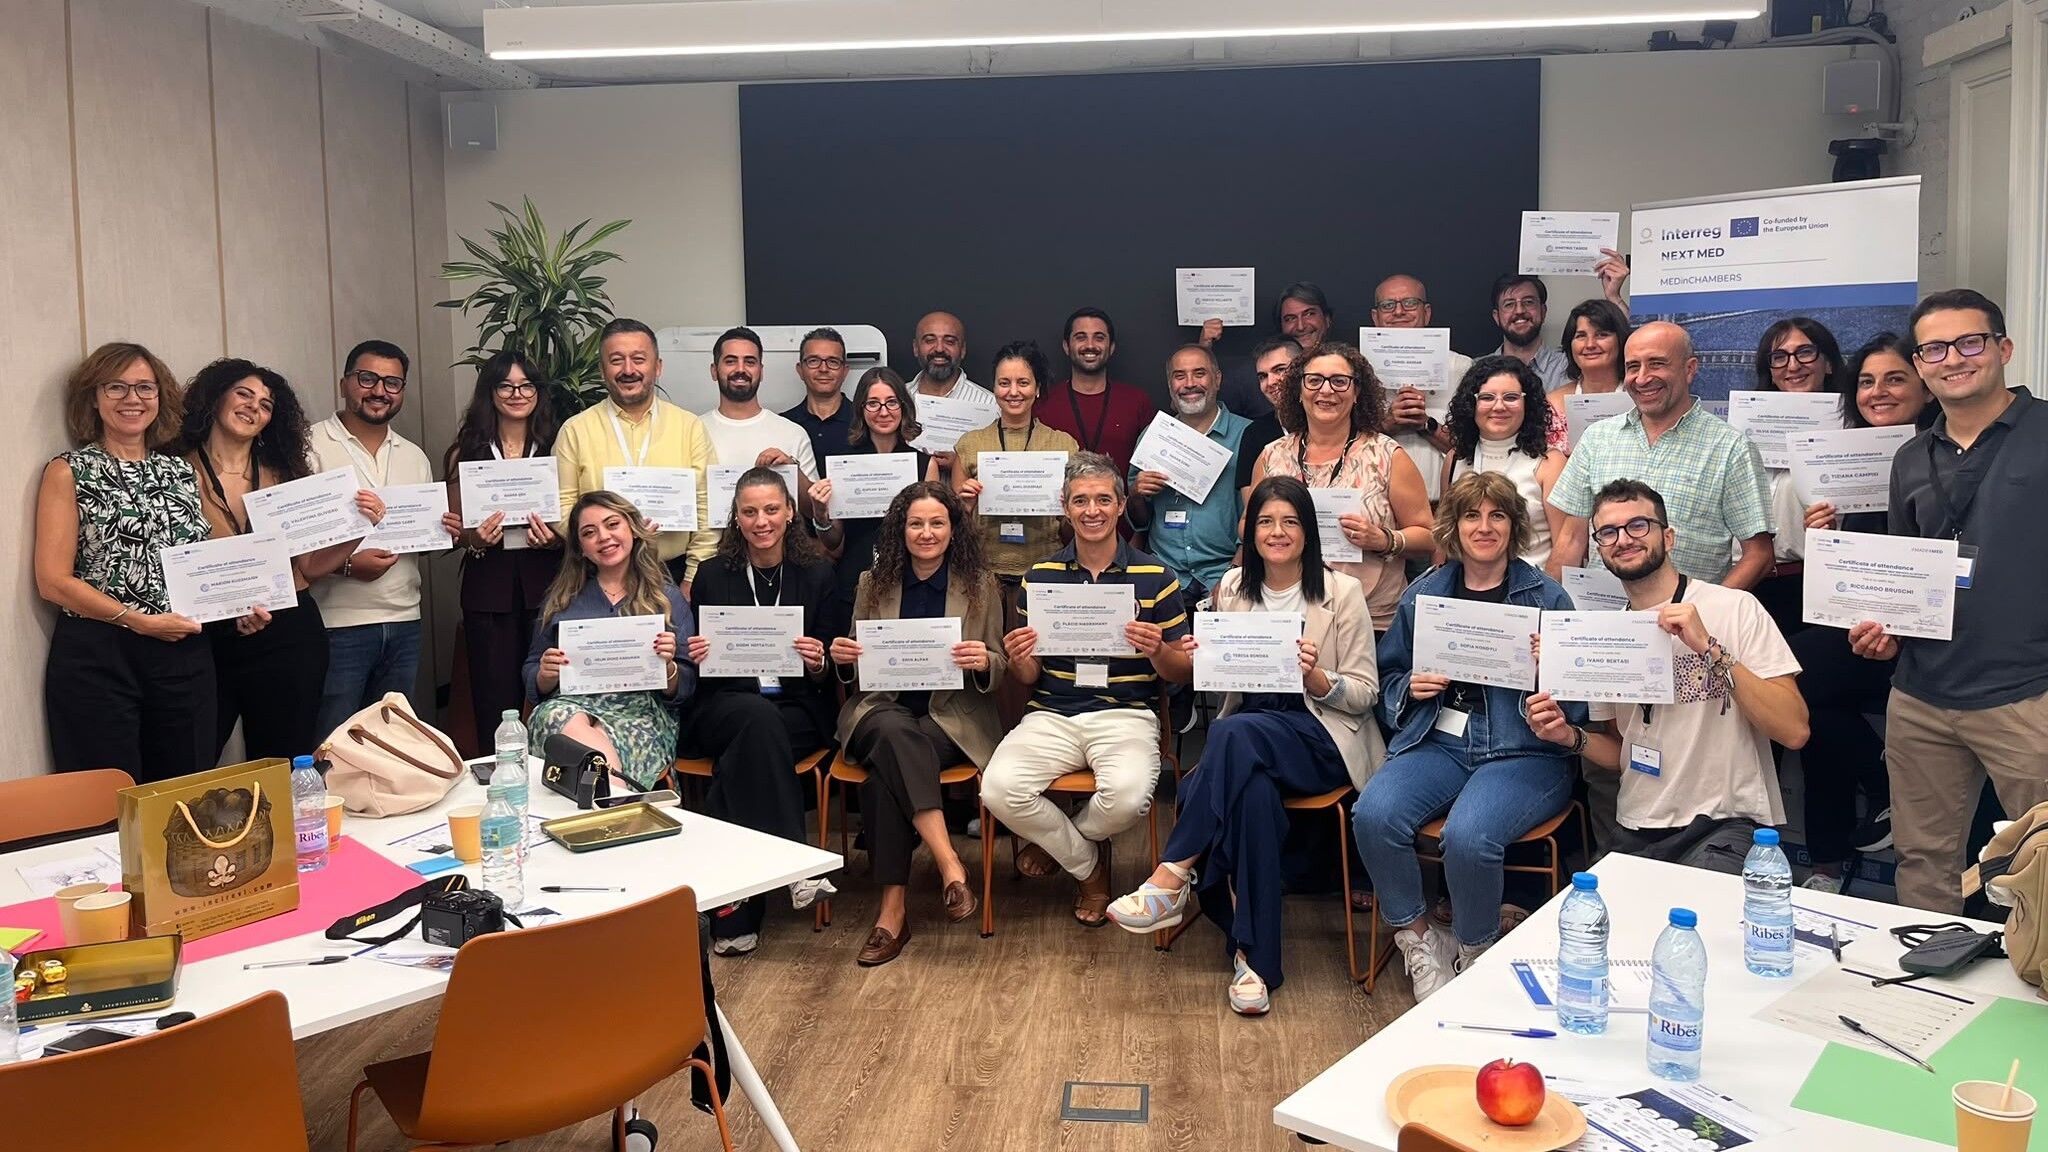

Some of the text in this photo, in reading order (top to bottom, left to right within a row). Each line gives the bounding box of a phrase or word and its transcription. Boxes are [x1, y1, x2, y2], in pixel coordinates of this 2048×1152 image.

[1763, 216, 1808, 224] Co-funded by
[1661, 226, 1722, 241] Interreg
[1775, 224, 1808, 233] European
[1808, 222, 1829, 230] Union
[1661, 248, 1725, 261] NEXT MED
[1660, 273, 1742, 286] MEDinCHAMBERS
[1838, 558, 1869, 567] Certificate
[1876, 562, 1914, 572] attendance
[1850, 582, 1914, 595] RICCARDO BRUSCHI
[1476, 626, 1505, 634] attendance
[1752, 924, 1784, 940] Ribes
[1660, 1020, 1698, 1038] Ribes
